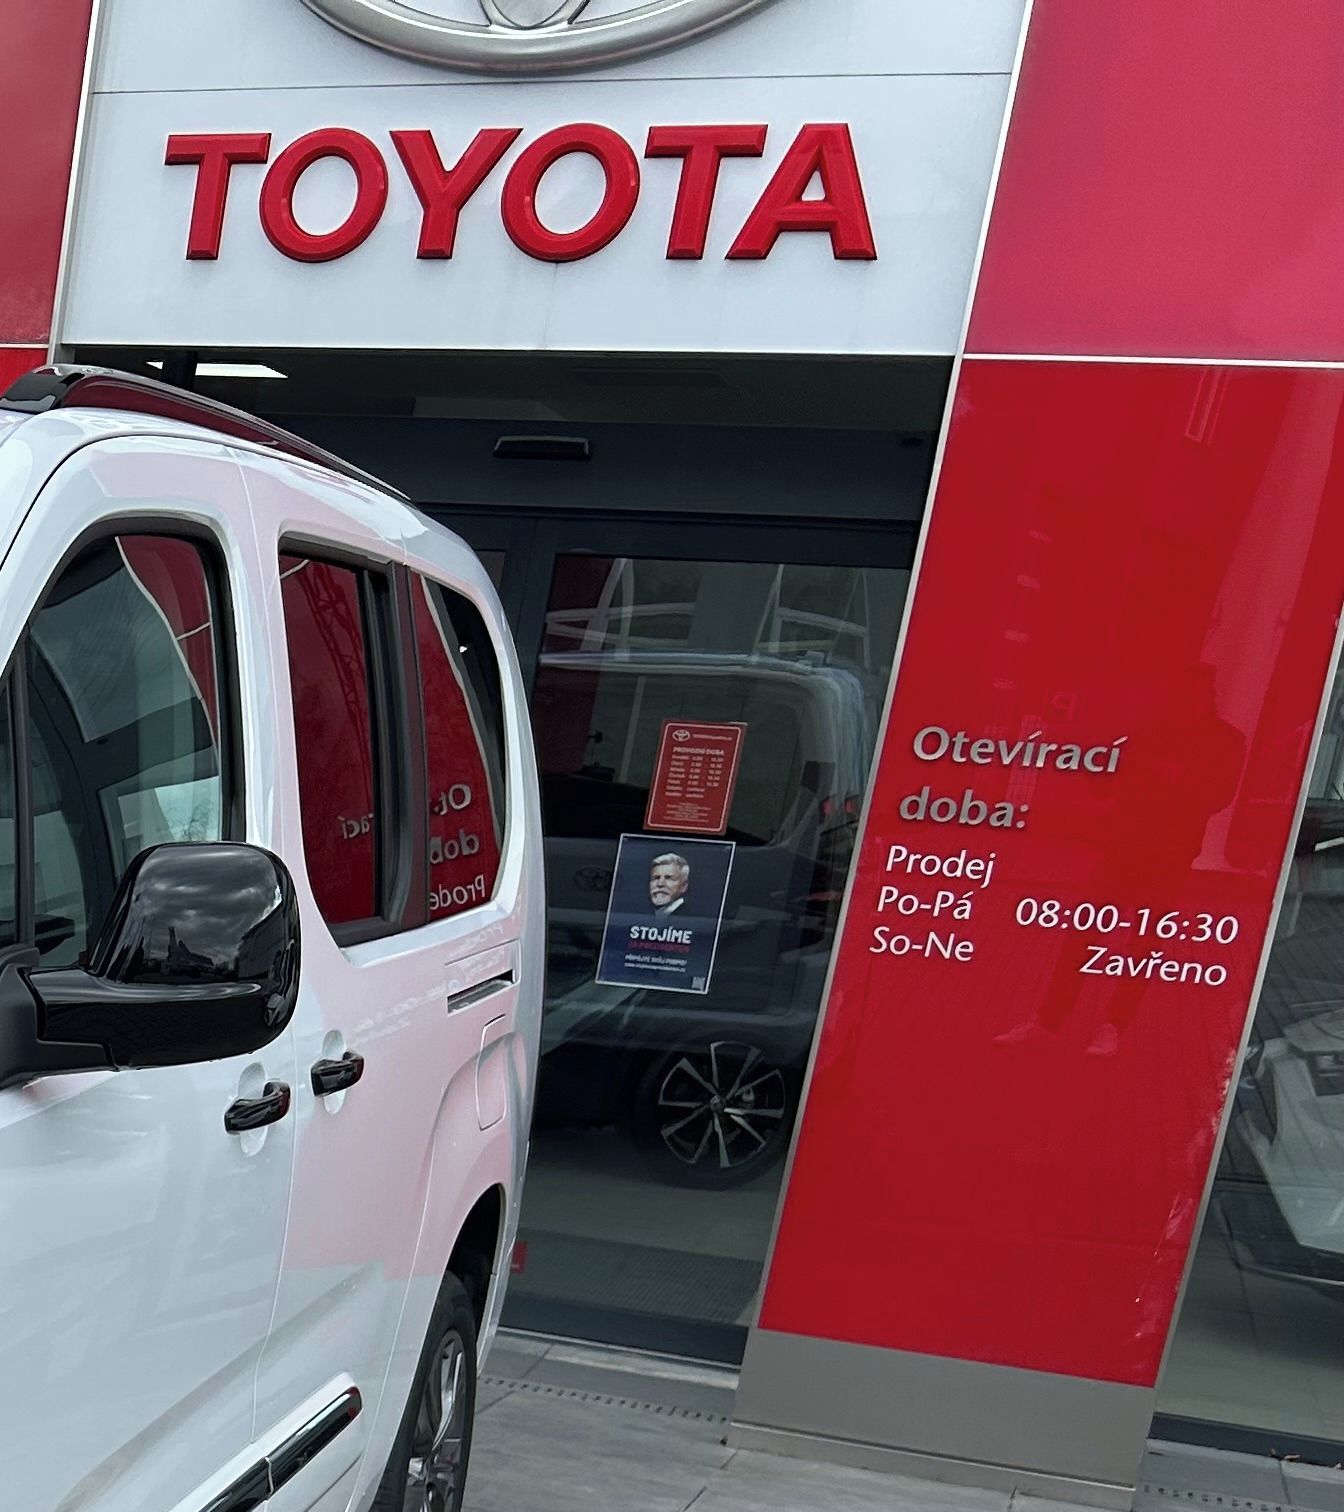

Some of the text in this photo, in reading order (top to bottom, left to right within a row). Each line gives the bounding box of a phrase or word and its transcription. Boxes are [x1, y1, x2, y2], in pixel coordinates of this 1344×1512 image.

[164, 122, 879, 261] TOYOTA
[912, 725, 1129, 773] Otevírací
[899, 786, 1030, 829] doba:
[884, 844, 997, 889] Prodej
[629, 925, 693, 945] STOJÍME
[877, 886, 1240, 945] Po-Pá 08:00-16:30
[869, 925, 1228, 986] So-Ne Zavřeno
